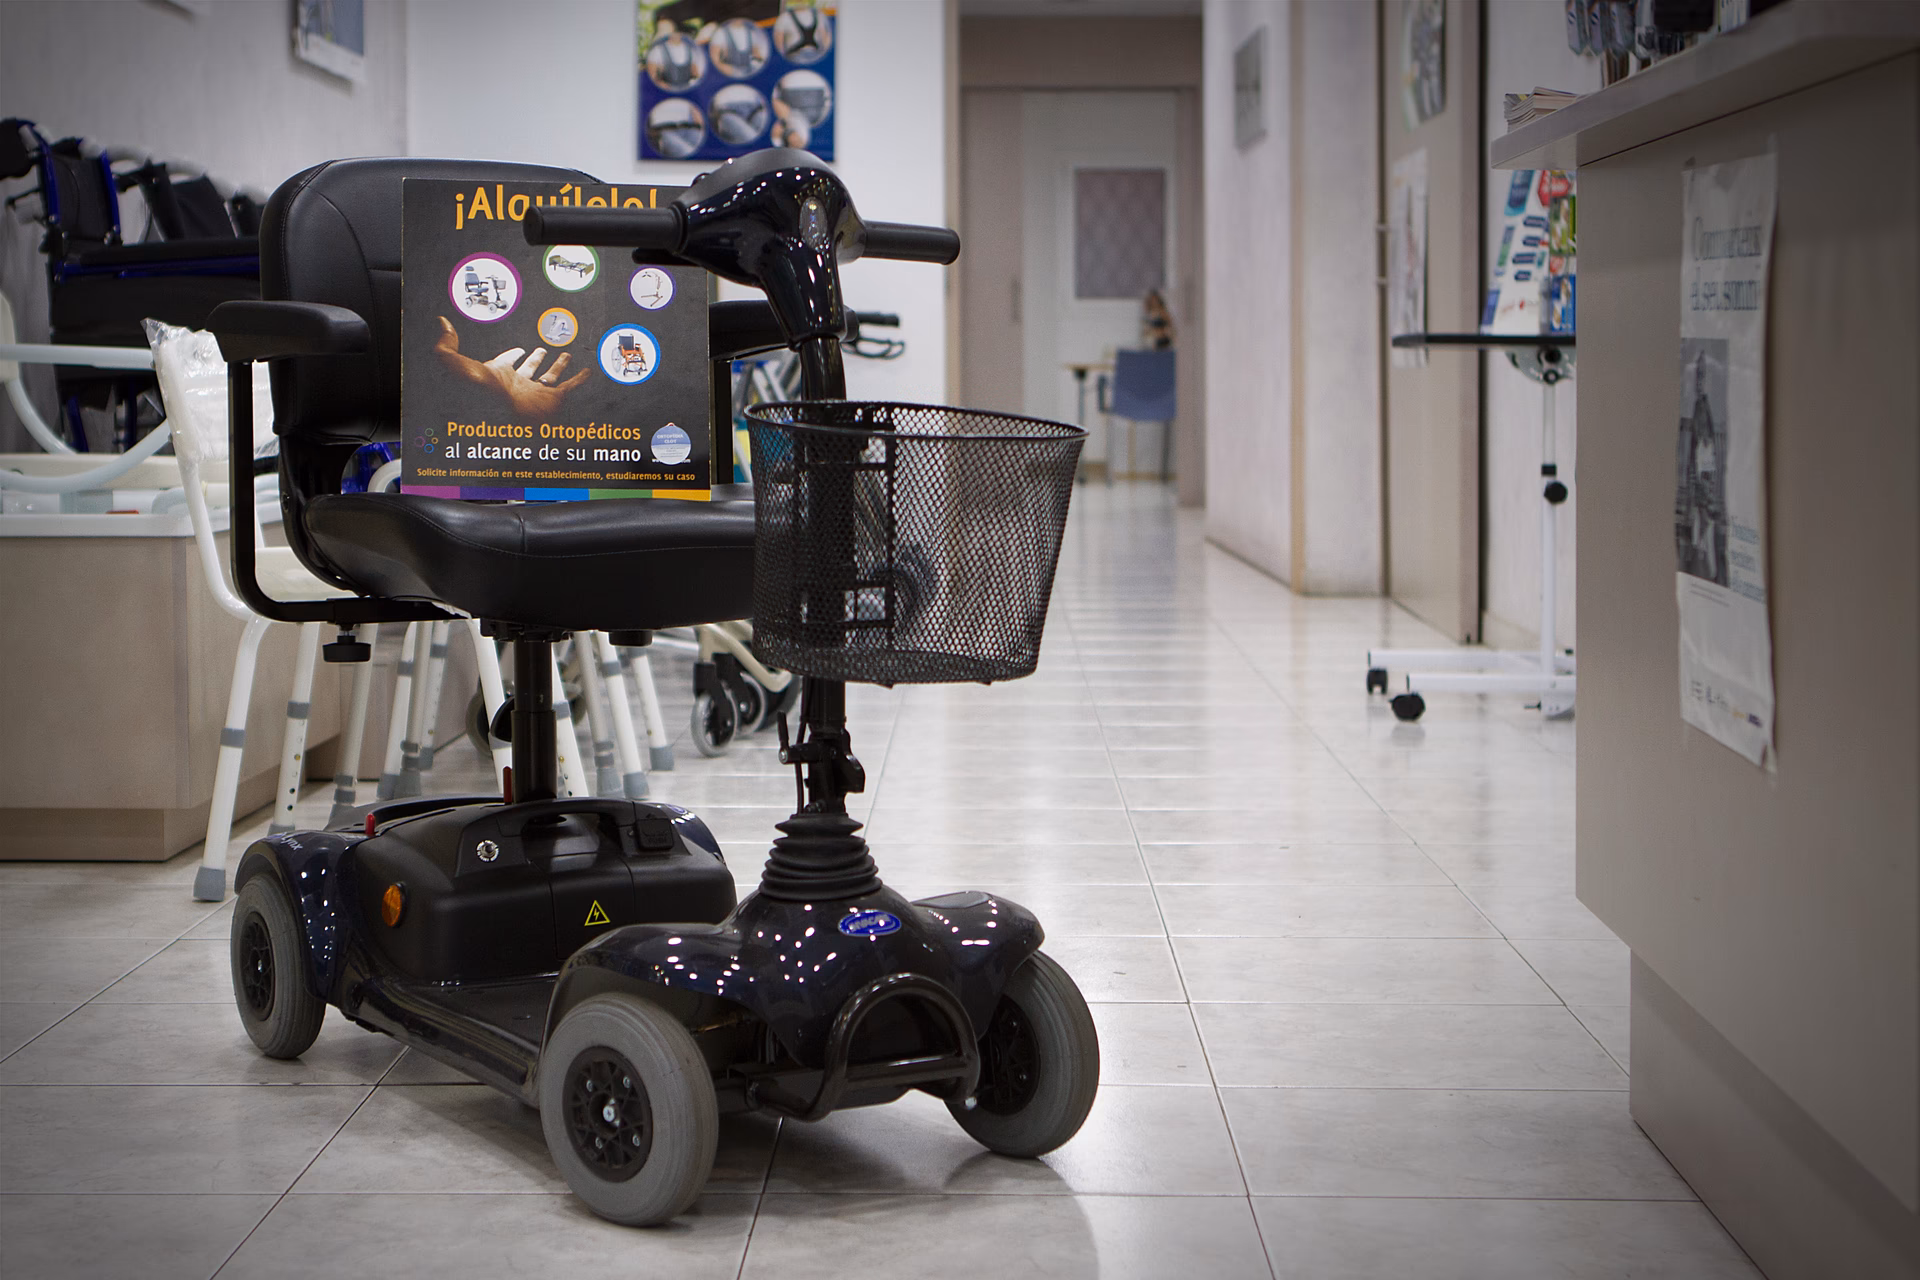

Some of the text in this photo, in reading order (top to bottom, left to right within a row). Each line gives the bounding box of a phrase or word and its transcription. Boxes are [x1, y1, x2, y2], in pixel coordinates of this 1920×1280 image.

[447, 421, 641, 442] Productos Ortopédicos
[445, 442, 460, 459] al
[467, 442, 532, 460] alcance
[539, 444, 560, 460] de
[566, 448, 586, 461] su
[594, 448, 641, 462] mano
[416, 467, 696, 481] Solicite información en este establecimiento, estudiaremos su caso
